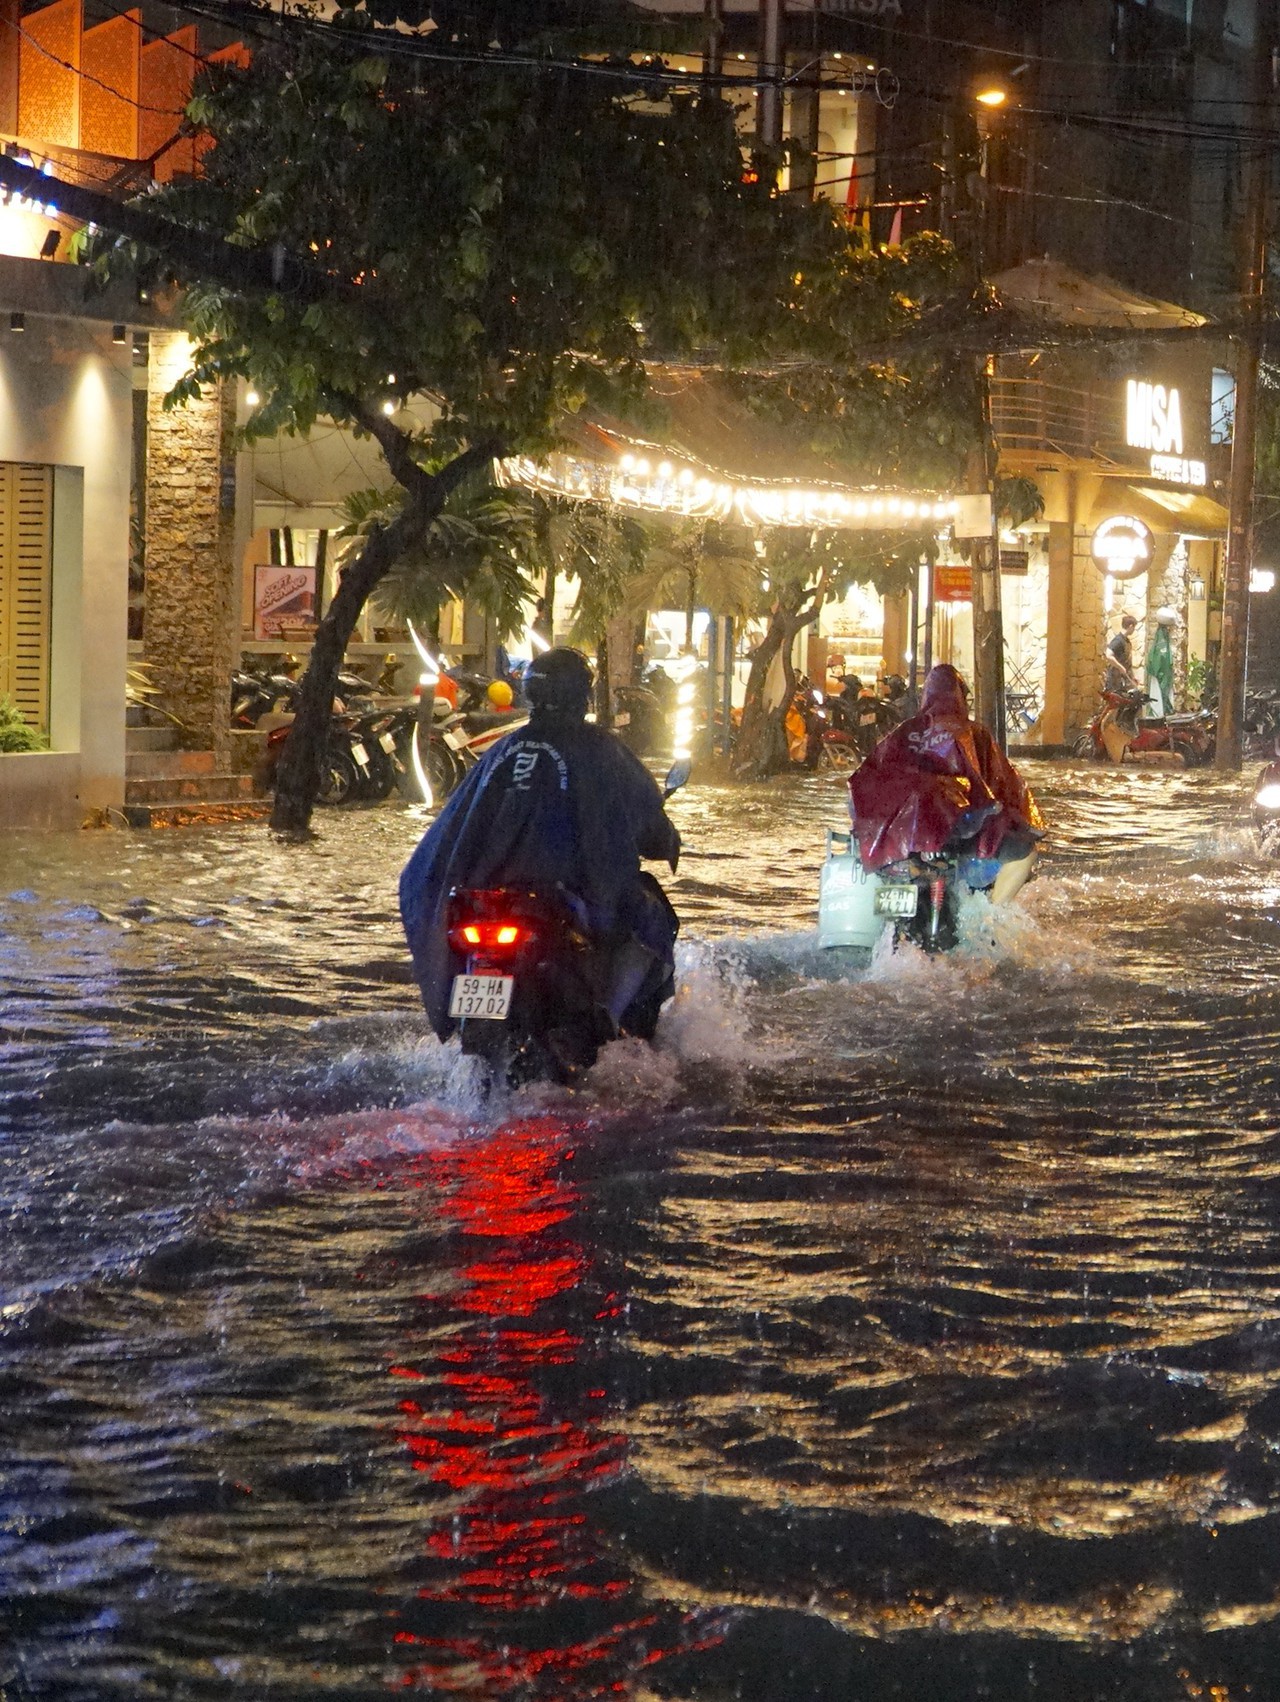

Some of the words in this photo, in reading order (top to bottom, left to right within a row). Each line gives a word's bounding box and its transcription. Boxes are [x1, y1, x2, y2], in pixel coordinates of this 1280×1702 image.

[1126, 379, 1183, 455] MISA
[260, 574, 308, 609] OPENING
[462, 978, 504, 996] 59-HA
